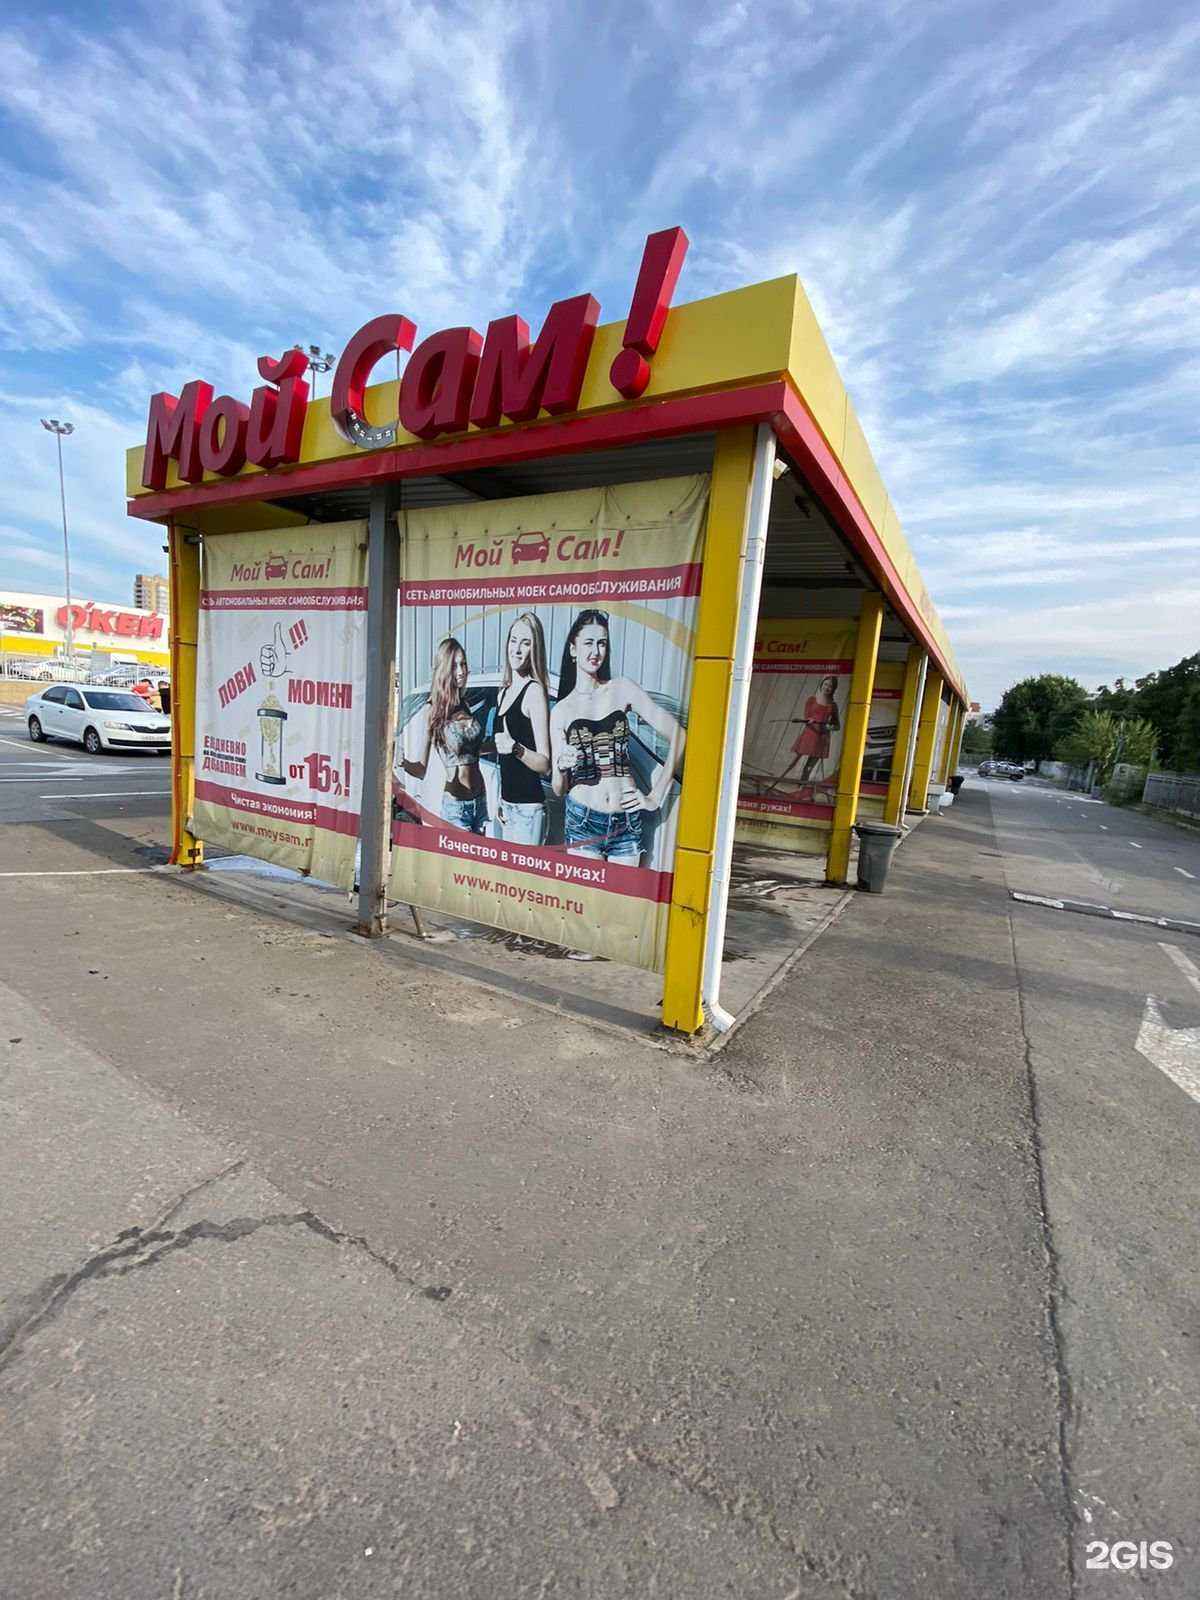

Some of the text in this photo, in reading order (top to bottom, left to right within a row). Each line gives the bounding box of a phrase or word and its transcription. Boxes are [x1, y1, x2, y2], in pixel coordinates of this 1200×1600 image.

[142, 226, 690, 490] Мой Сам!
[455, 530, 625, 569] Мой Сам!
[231, 558, 331, 581] Мой Сам!
[406, 575, 681, 600] СЕТЬ АВТОМОБИЛЬНЫХ МОЕК САМООБСЛУЖИВАНИЯ
[218, 662, 256, 709] ЛОВИ
[262, 802, 317, 819] экономия!
[232, 820, 313, 848] www.moysam.r
[438, 835, 606, 883] Качество в твоих руках!
[453, 872, 584, 915] www.moysam.ru
